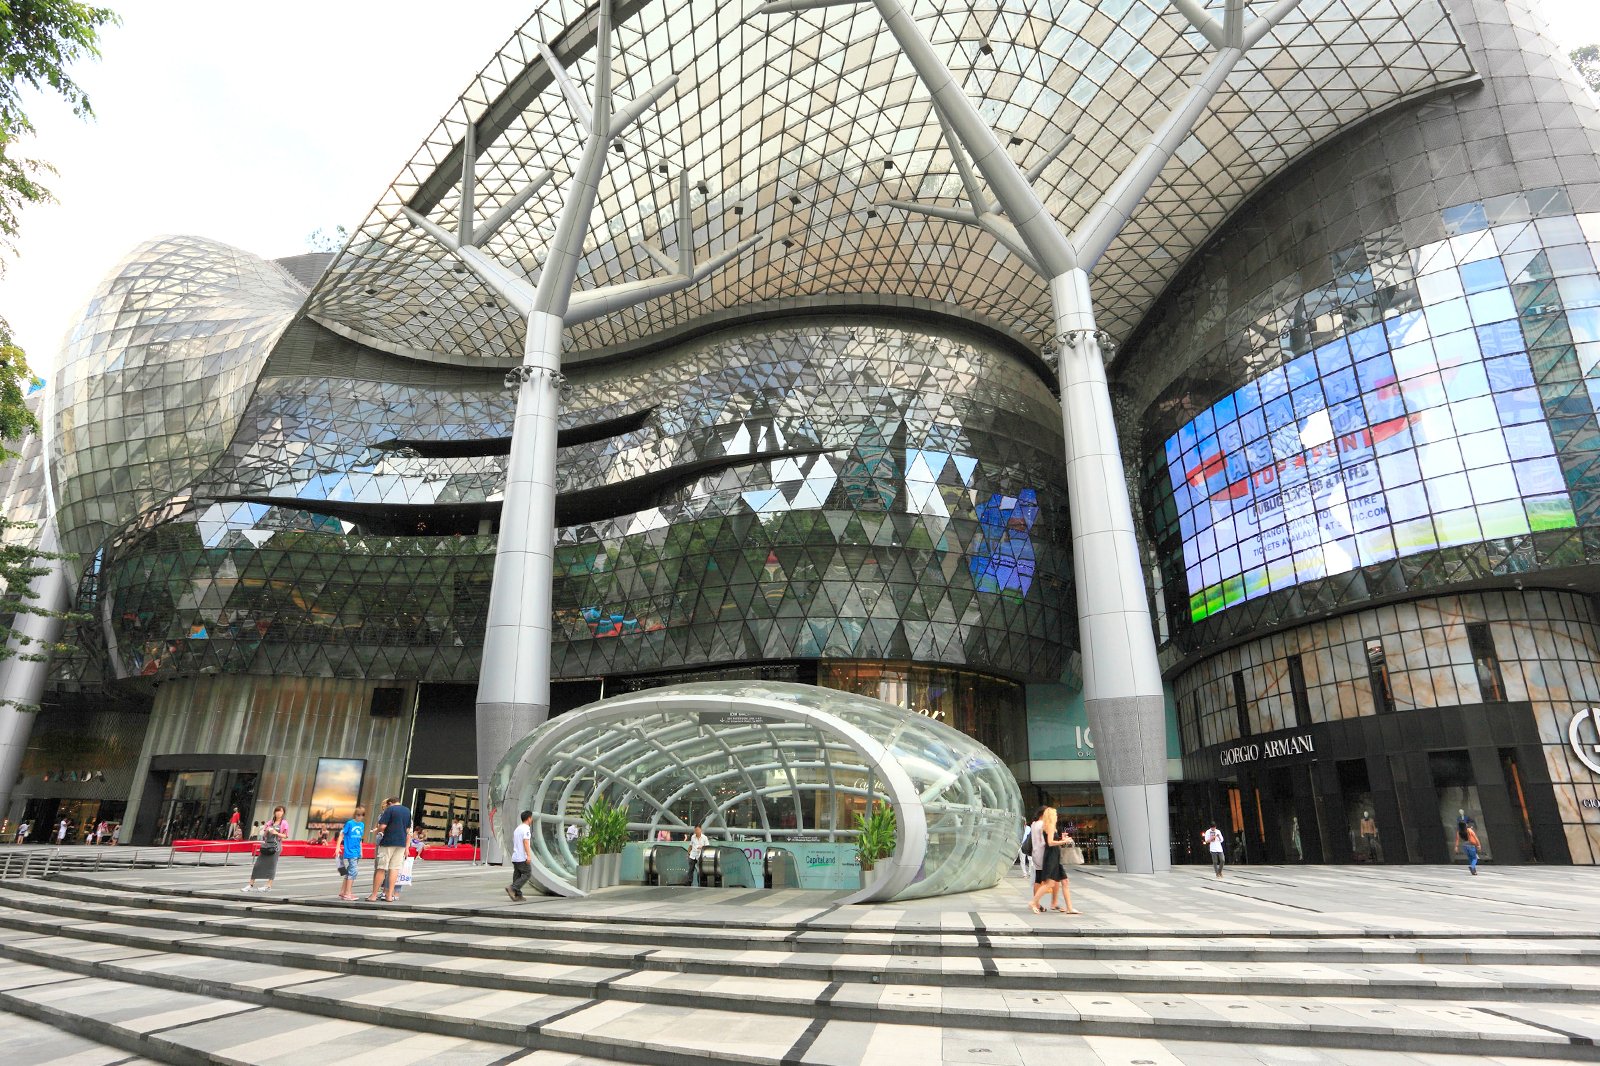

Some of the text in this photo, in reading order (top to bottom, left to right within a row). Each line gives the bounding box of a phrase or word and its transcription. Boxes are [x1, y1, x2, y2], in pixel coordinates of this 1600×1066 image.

[1220, 734, 1315, 766] GIORGIO ARMANI
[805, 854, 836, 865] CapitaLand
